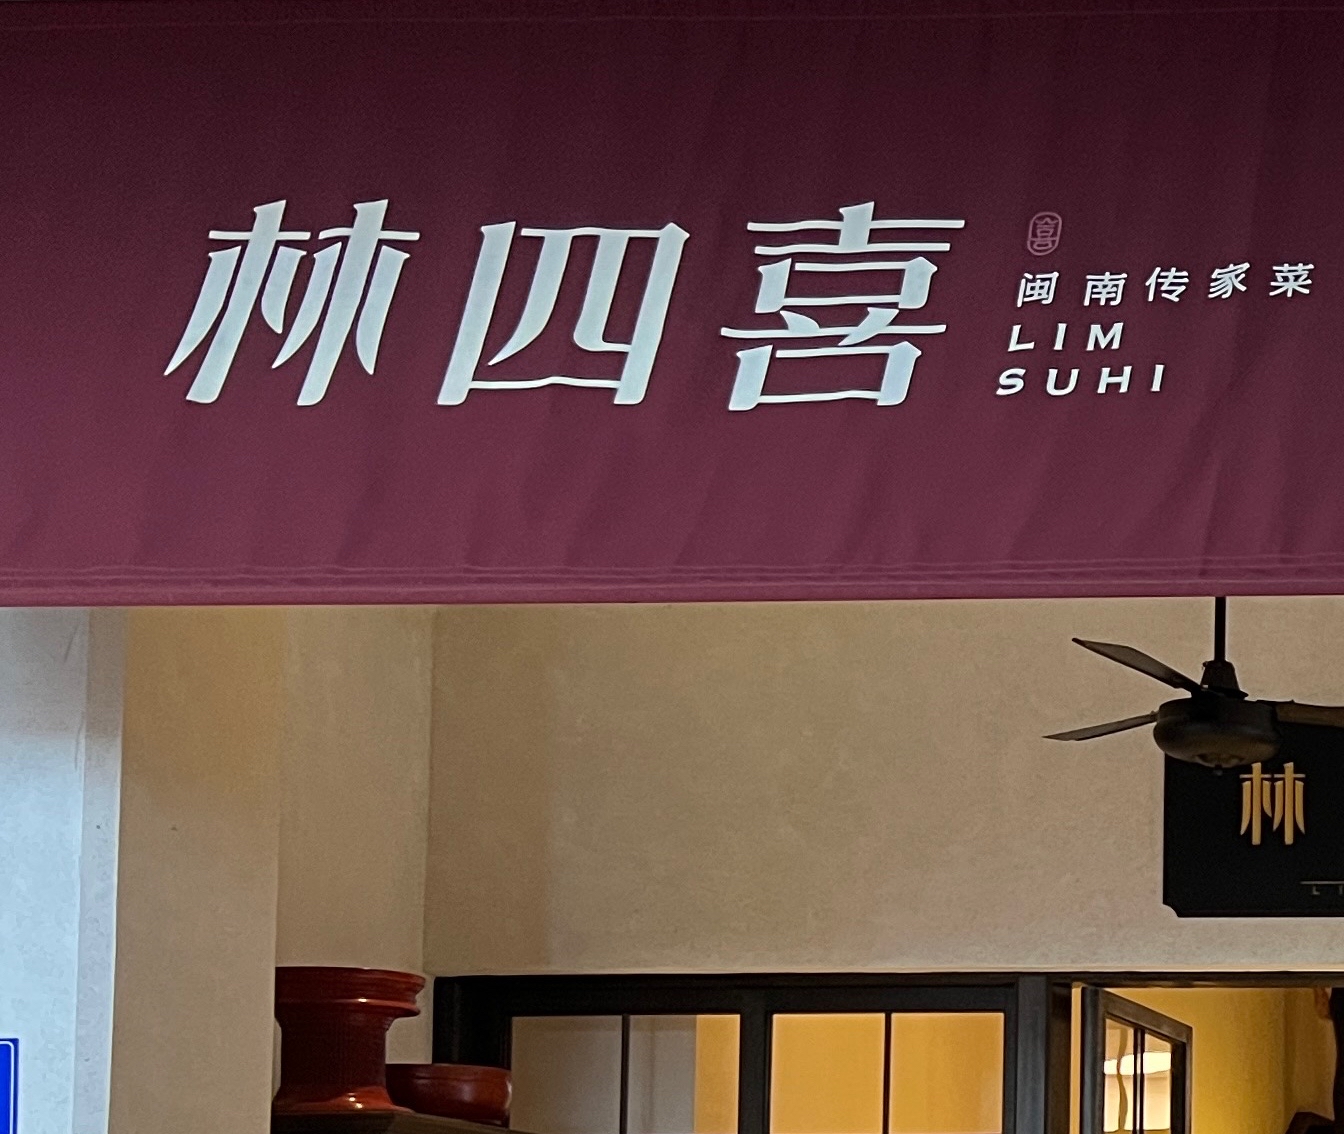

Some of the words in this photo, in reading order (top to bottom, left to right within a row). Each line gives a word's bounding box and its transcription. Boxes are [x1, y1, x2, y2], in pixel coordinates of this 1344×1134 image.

[164, 198, 966, 411] 林四喜
[1016, 262, 1316, 308] 闽南传家菜
[1007, 321, 1125, 352] LIM
[995, 363, 1166, 397] SUHI
